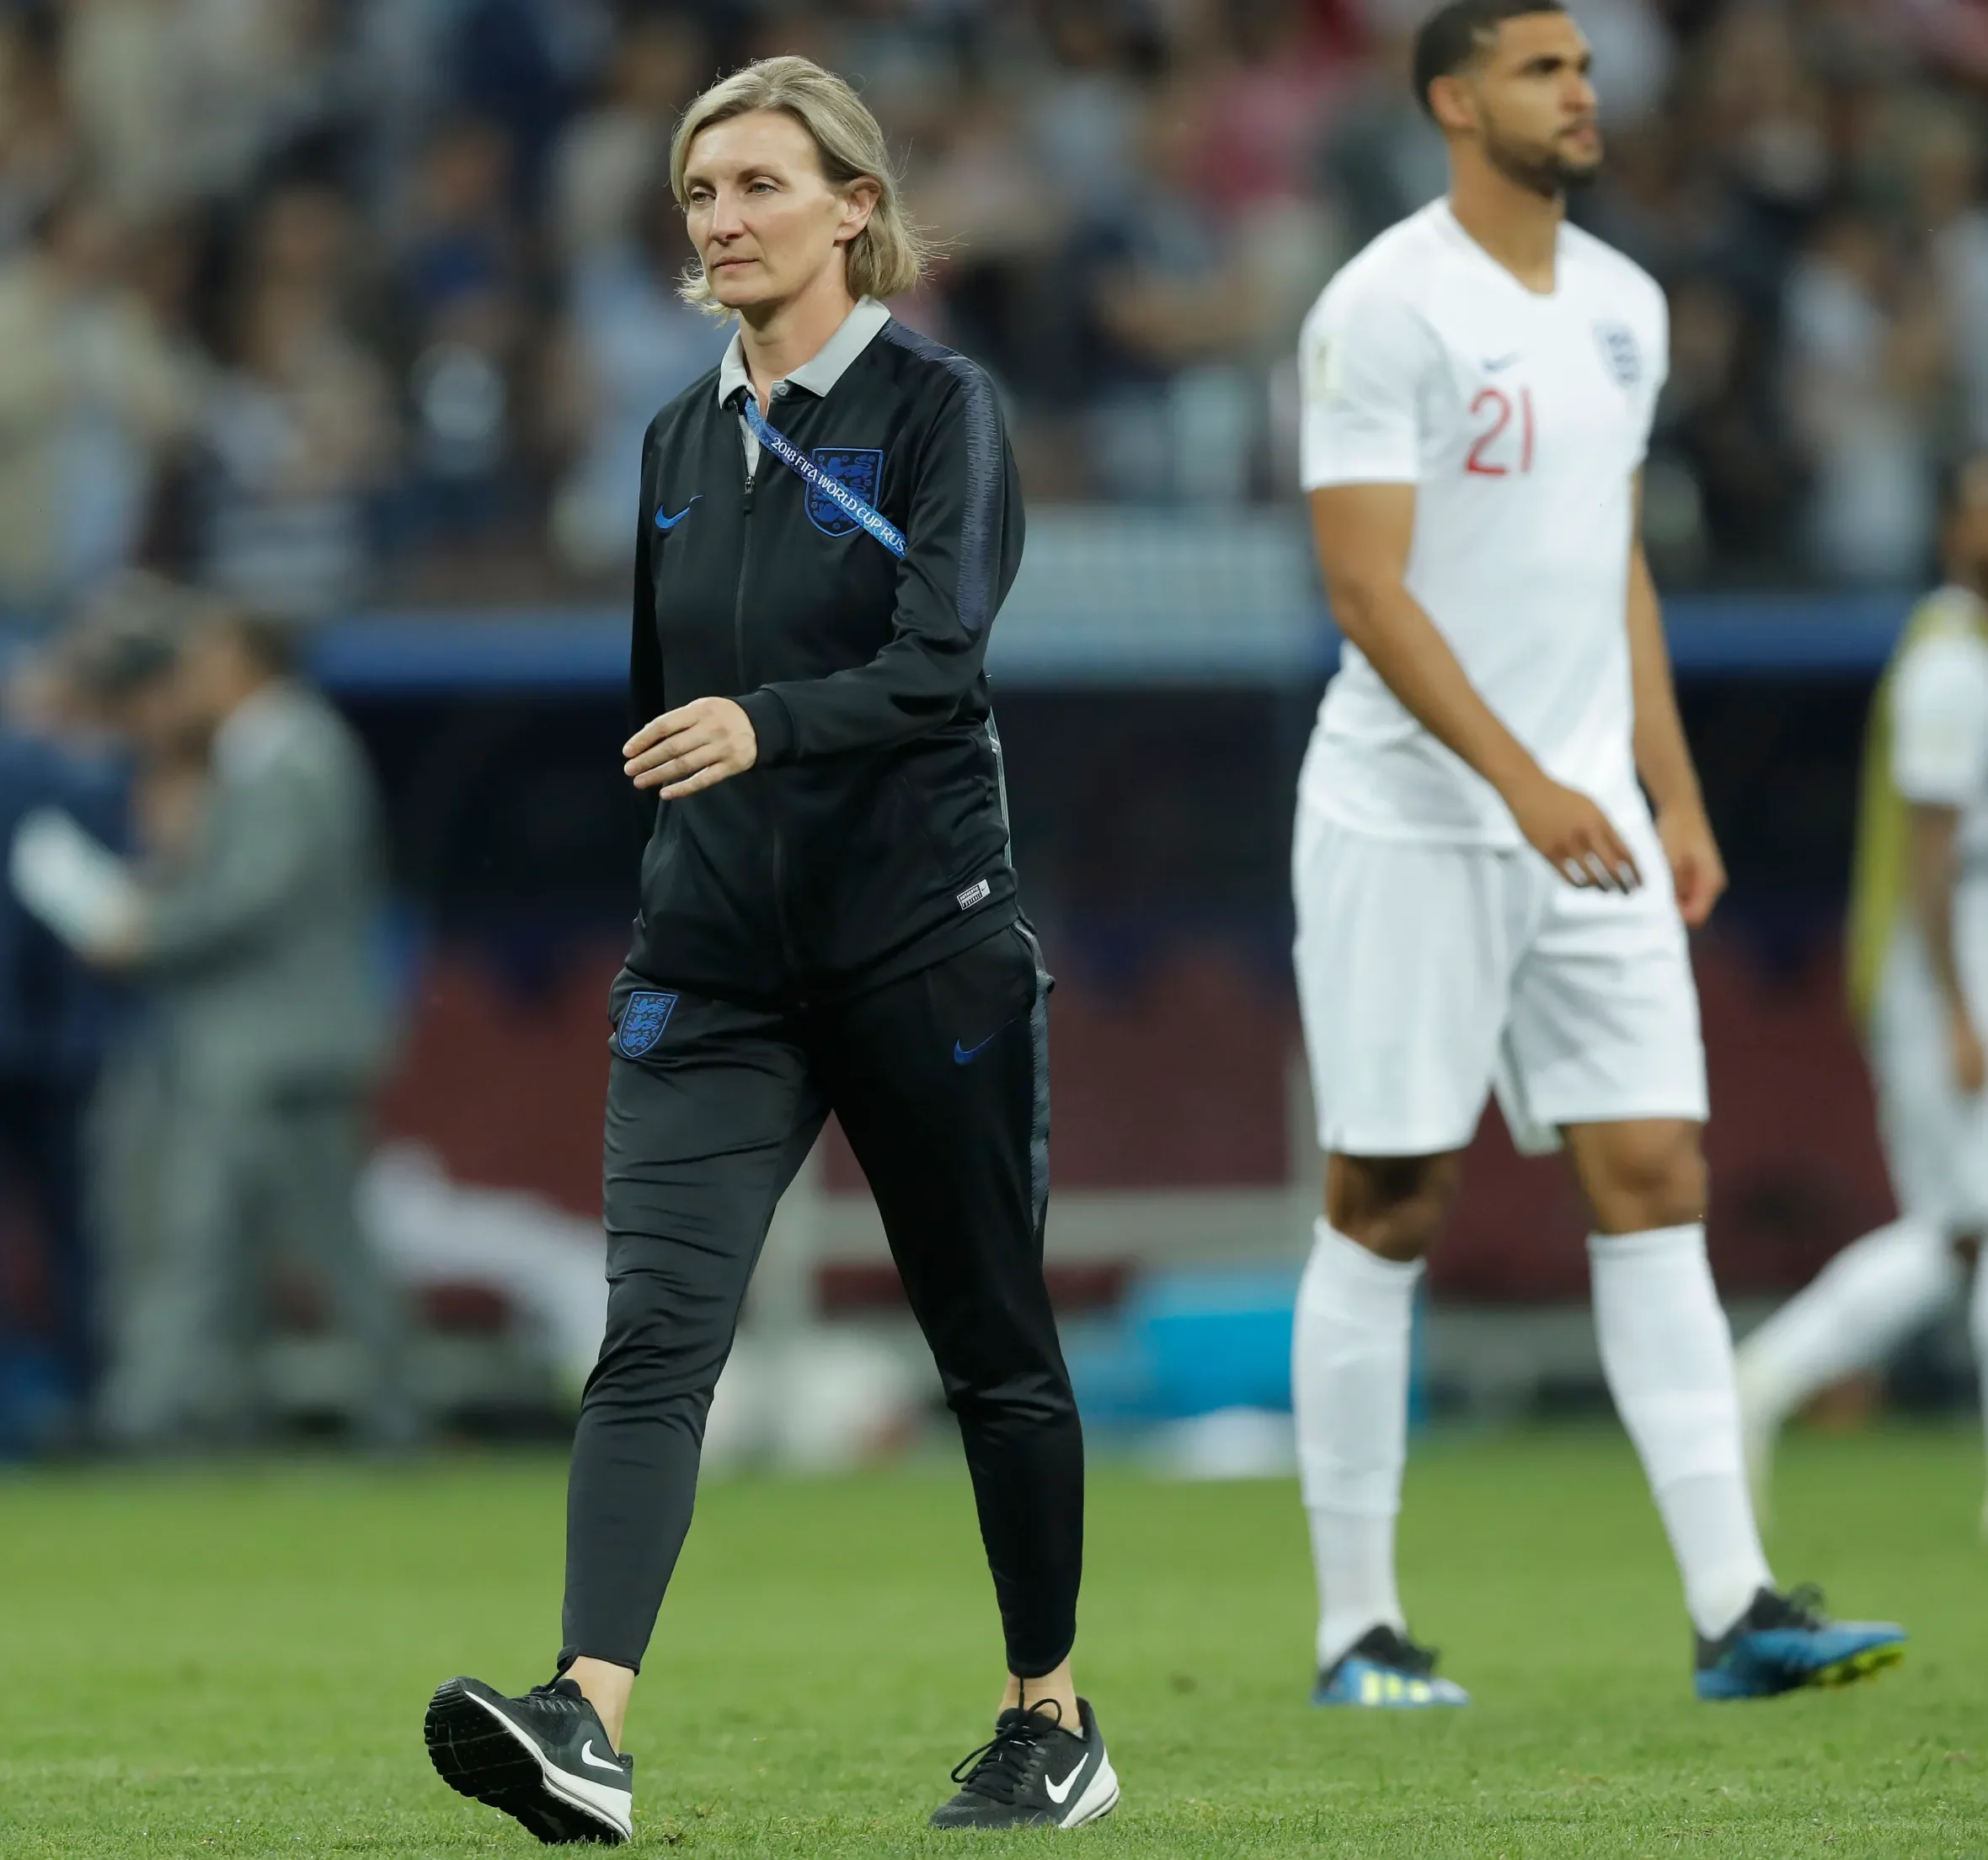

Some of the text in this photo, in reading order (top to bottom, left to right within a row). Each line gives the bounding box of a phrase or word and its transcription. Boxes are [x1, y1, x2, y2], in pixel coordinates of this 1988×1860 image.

[1464, 387, 1535, 474] 21
[771, 436, 796, 462] 2018
[794, 456, 818, 481] FIFA
[817, 474, 858, 510] WORLD
[856, 507, 883, 527] CUP
